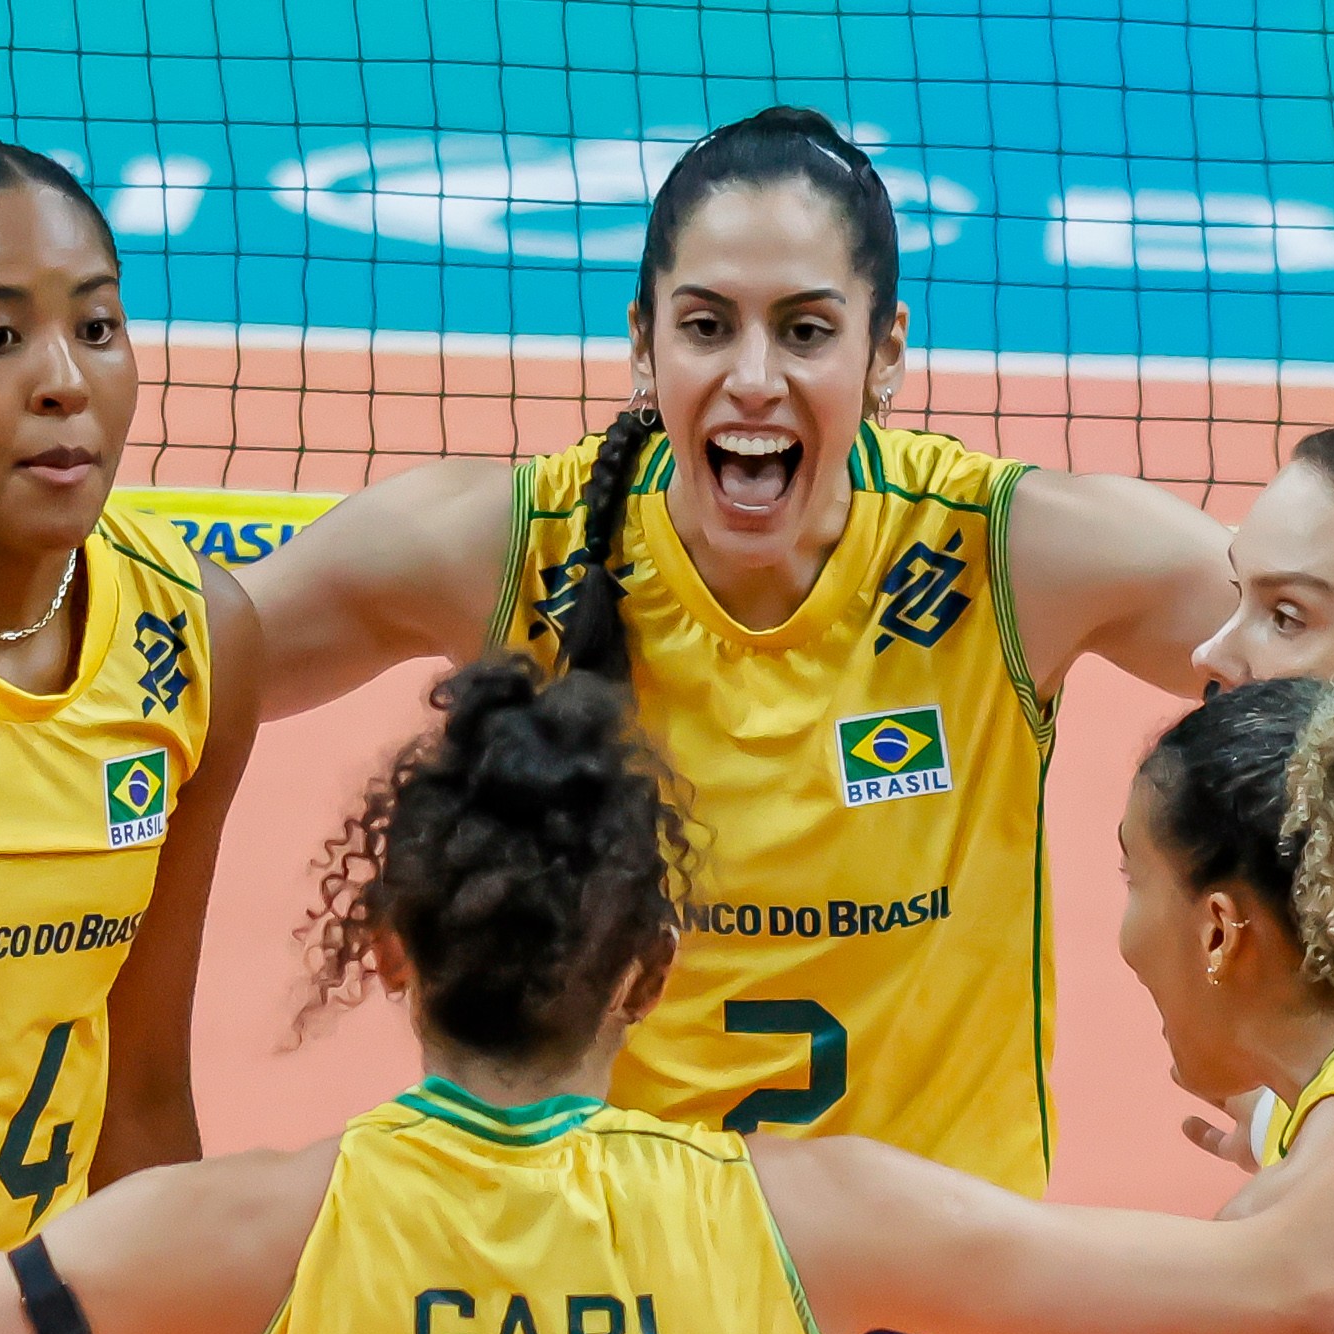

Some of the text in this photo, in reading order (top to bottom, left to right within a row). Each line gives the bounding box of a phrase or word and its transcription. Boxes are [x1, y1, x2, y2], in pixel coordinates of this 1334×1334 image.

[847, 771, 949, 803] BRASIL
[111, 817, 164, 846] BRASIL
[769, 905, 822, 937] DO
[828, 886, 952, 937] BRASIL
[34, 921, 75, 955] DO
[75, 913, 143, 951] BRAS
[723, 999, 847, 1134] 2
